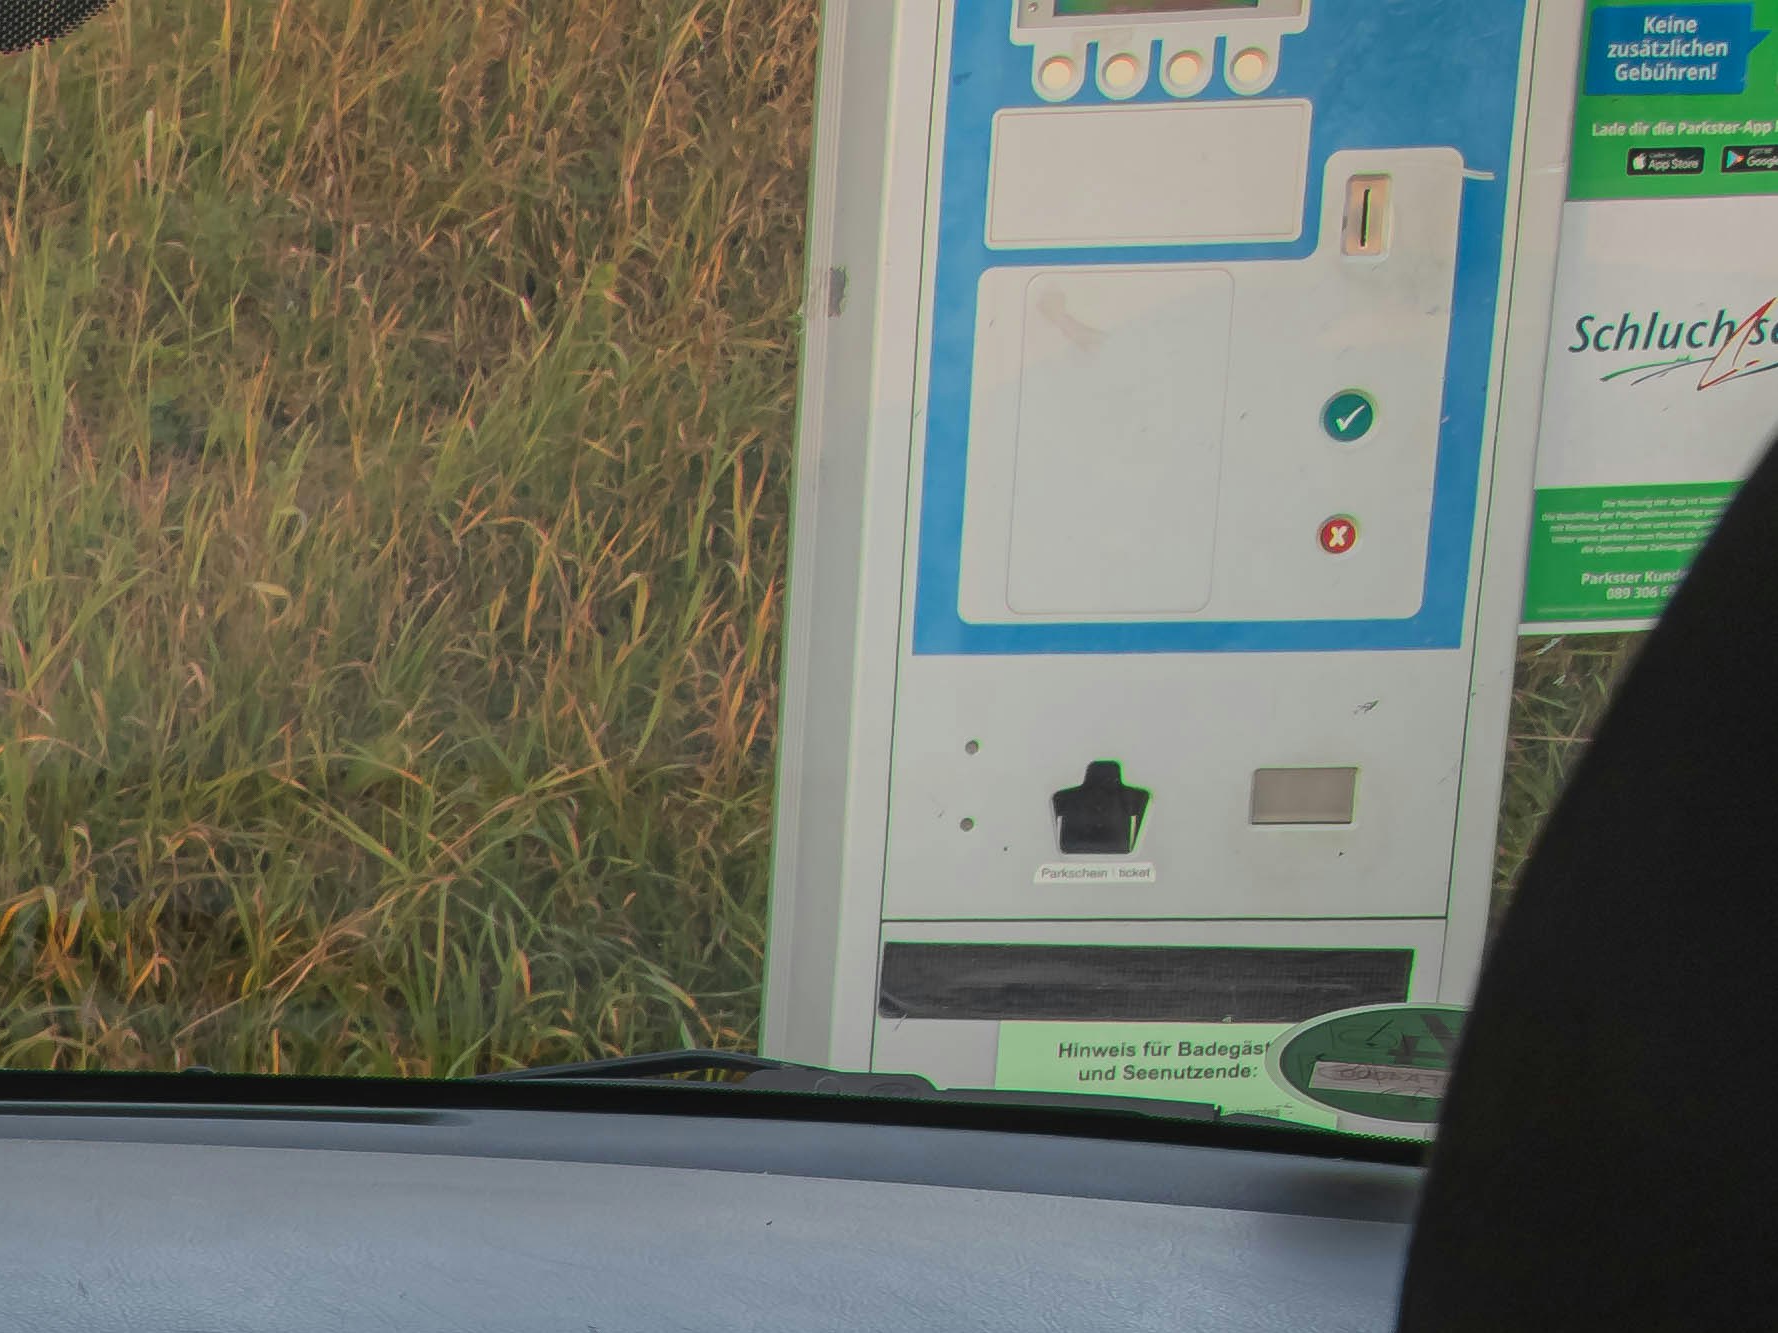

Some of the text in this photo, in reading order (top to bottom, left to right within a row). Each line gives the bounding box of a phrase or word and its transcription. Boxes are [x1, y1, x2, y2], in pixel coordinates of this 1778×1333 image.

[1644, 16, 1698, 34] Keine
[1607, 39, 1729, 59] zusätzlichen
[1614, 63, 1718, 82] Gebühren!
[1592, 122, 1627, 137] Lade
[1628, 121, 1650, 136] dir
[1652, 120, 1674, 136] die
[1581, 571, 1642, 585] Parkster
[1041, 866, 1151, 880] Parkschein ticket
[1058, 1042, 1136, 1058] Hinweis
[1142, 1041, 1172, 1058] für
[1078, 1063, 1258, 1081] und Seenutzende:
